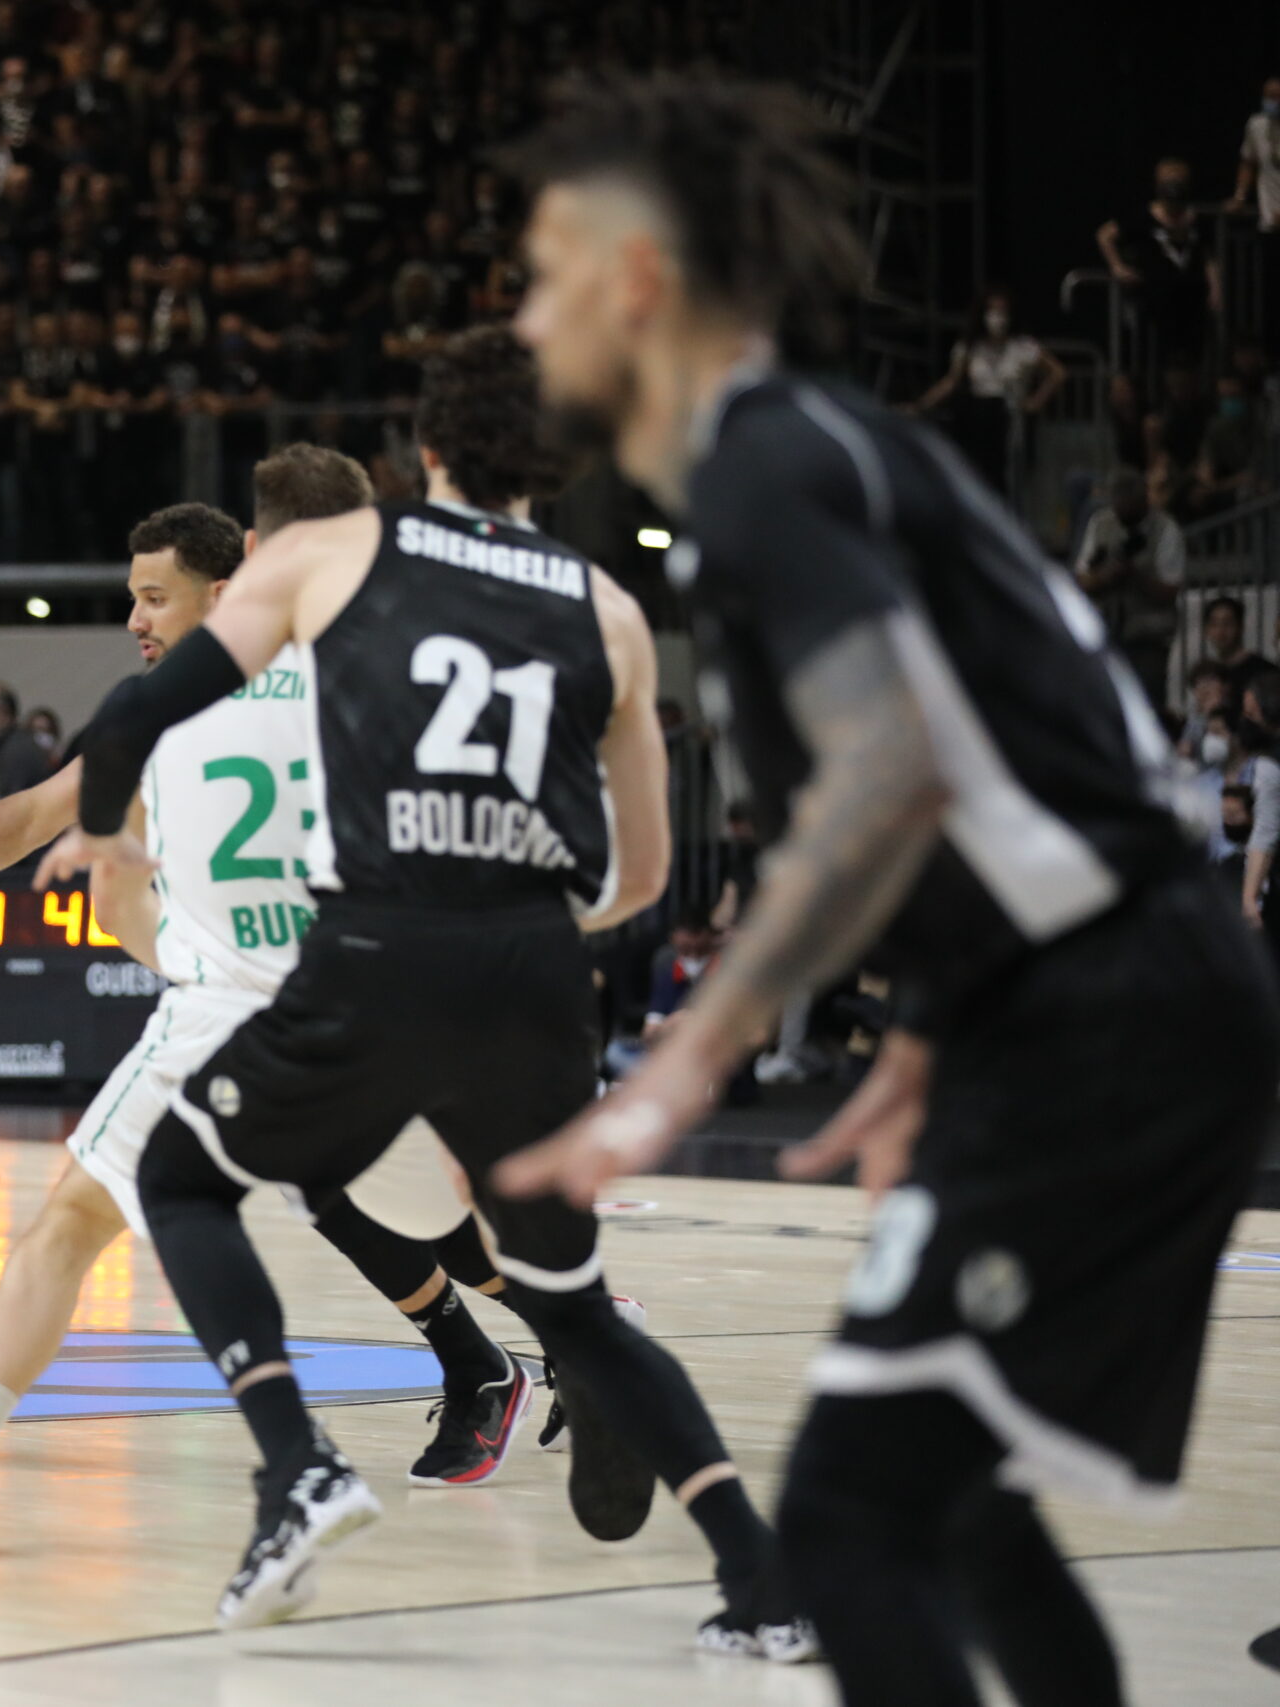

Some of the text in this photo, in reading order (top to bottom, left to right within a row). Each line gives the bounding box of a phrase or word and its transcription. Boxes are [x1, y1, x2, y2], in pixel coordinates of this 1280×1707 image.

[397, 516, 587, 600] SHENGELIA
[230, 668, 306, 700] DZI
[410, 634, 556, 802] 21
